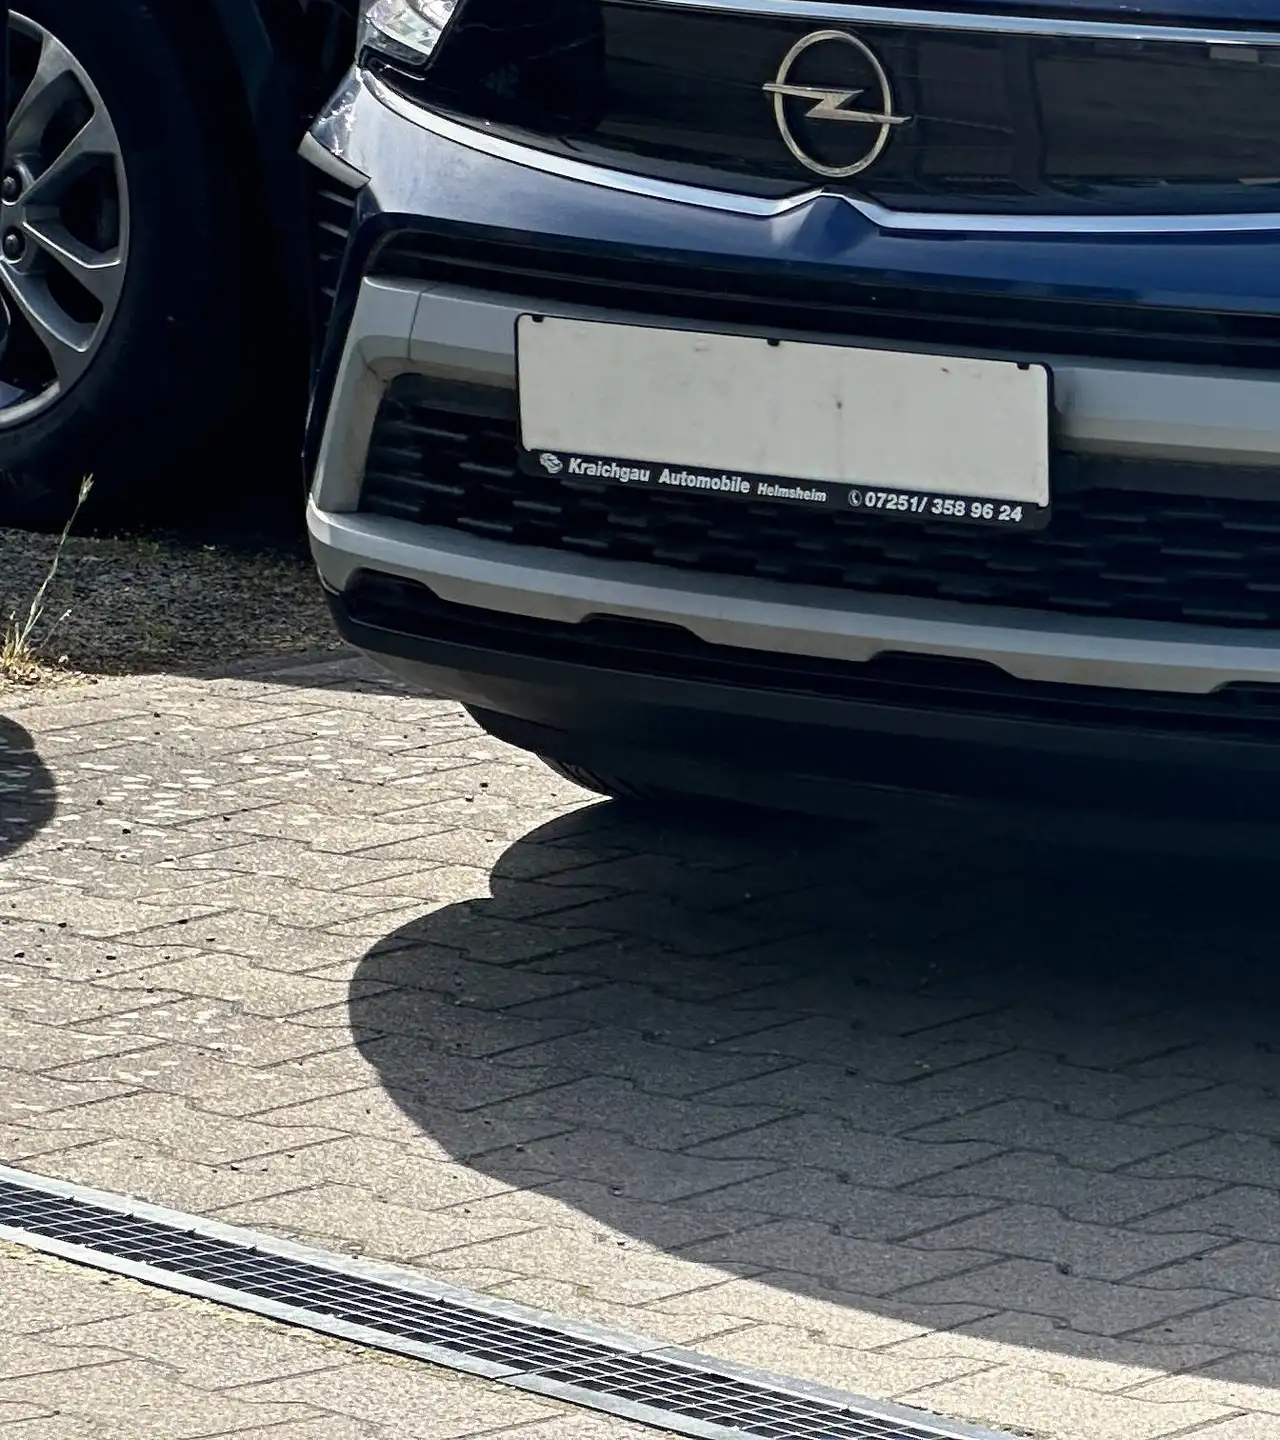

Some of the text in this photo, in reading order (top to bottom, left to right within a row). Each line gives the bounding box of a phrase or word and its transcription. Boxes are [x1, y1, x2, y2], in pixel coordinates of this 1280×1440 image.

[568, 457, 827, 502] Kraichgau Automobile Helmsheim
[931, 498, 966, 517] 358
[970, 502, 994, 520] 96
[998, 505, 1023, 522] 24
